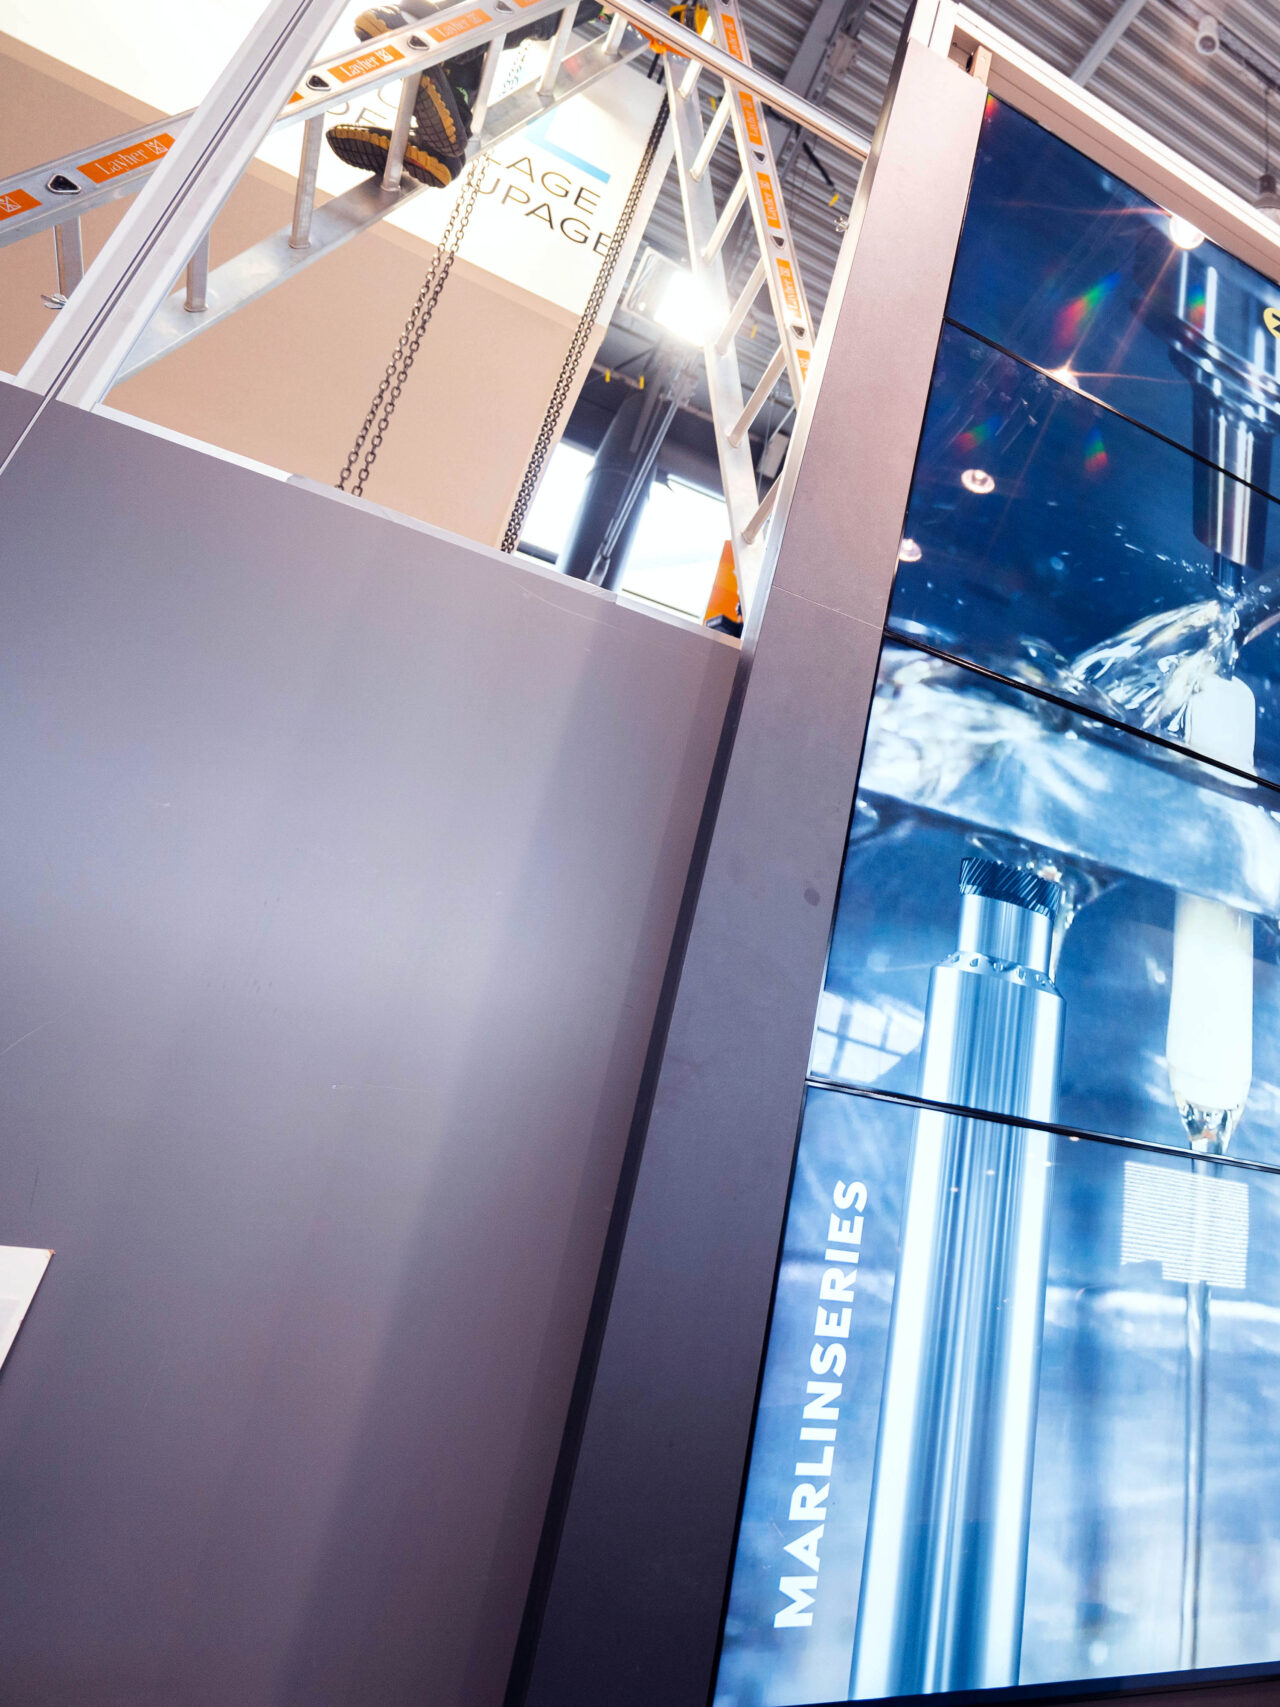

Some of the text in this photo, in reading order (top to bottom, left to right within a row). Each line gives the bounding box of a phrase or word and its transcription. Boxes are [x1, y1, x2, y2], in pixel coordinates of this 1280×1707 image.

[339, 55, 380, 77] Layher
[94, 147, 149, 175] Layher
[773, 1179, 868, 1628] MARLINSERIES
